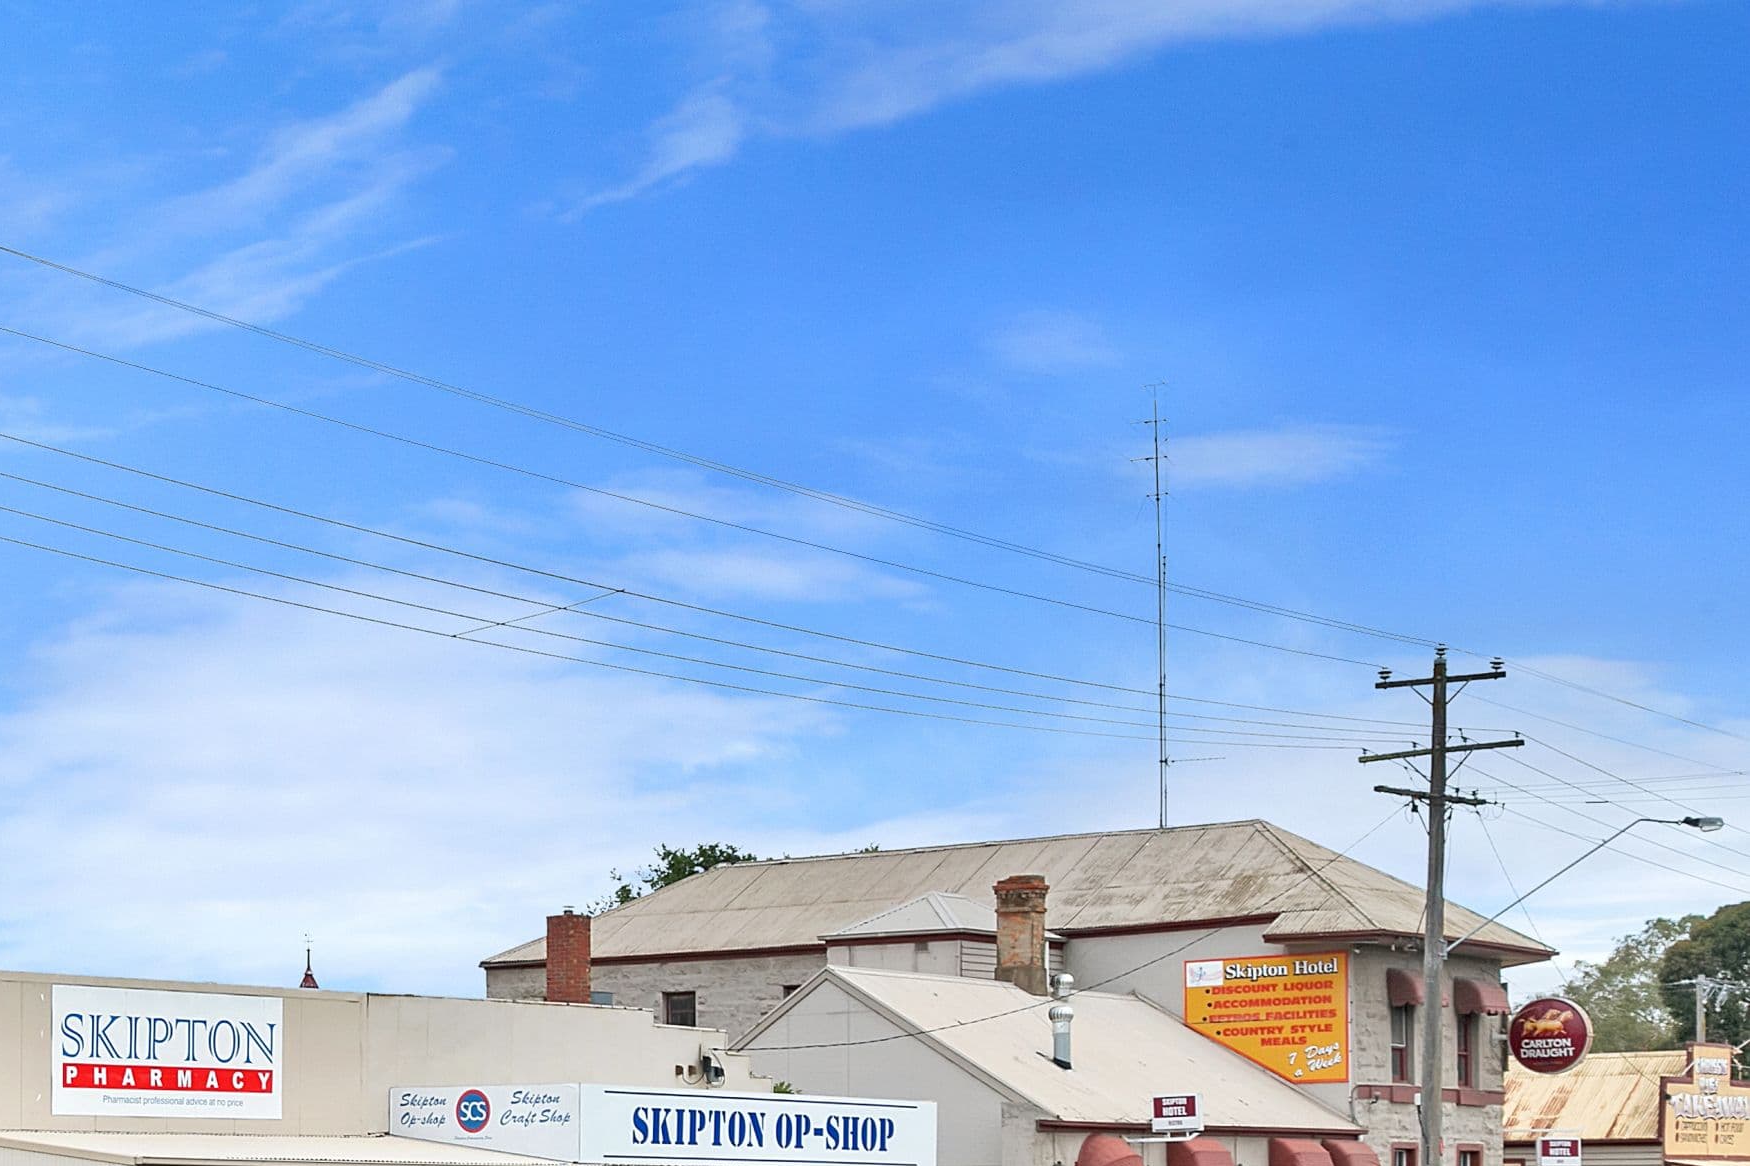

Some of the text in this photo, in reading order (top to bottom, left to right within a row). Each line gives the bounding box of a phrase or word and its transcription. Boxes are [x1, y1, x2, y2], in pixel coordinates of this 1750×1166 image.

[1225, 957, 1339, 981] Skipton Hotel
[1212, 980, 1334, 996] DISCOUNT LIQUOR
[1213, 995, 1332, 1010] ACCOMMODATION
[1265, 1009, 1337, 1022] FACILITIES
[1223, 1023, 1333, 1037] COUNTRY STYLE
[61, 1012, 277, 1065] SKIPTON
[1260, 1036, 1307, 1047] MEALS
[1521, 1038, 1572, 1049] CARLTON
[1288, 1042, 1340, 1065] 7 Days
[1520, 1047, 1575, 1059] DRAUGHT
[1294, 1052, 1342, 1077] a Week
[65, 1065, 271, 1090] PHARMACY
[102, 1094, 244, 1108] Pharmacist professional advice at no price
[399, 1093, 447, 1110] Skipton
[510, 1090, 562, 1107] Skipton
[459, 1101, 487, 1121] SCS
[499, 1108, 571, 1128] Craft Shop
[1162, 1106, 1188, 1116] HOTEL
[400, 1112, 446, 1128] Op-shop
[632, 1106, 895, 1152] SKIPTON OP-SHOP
